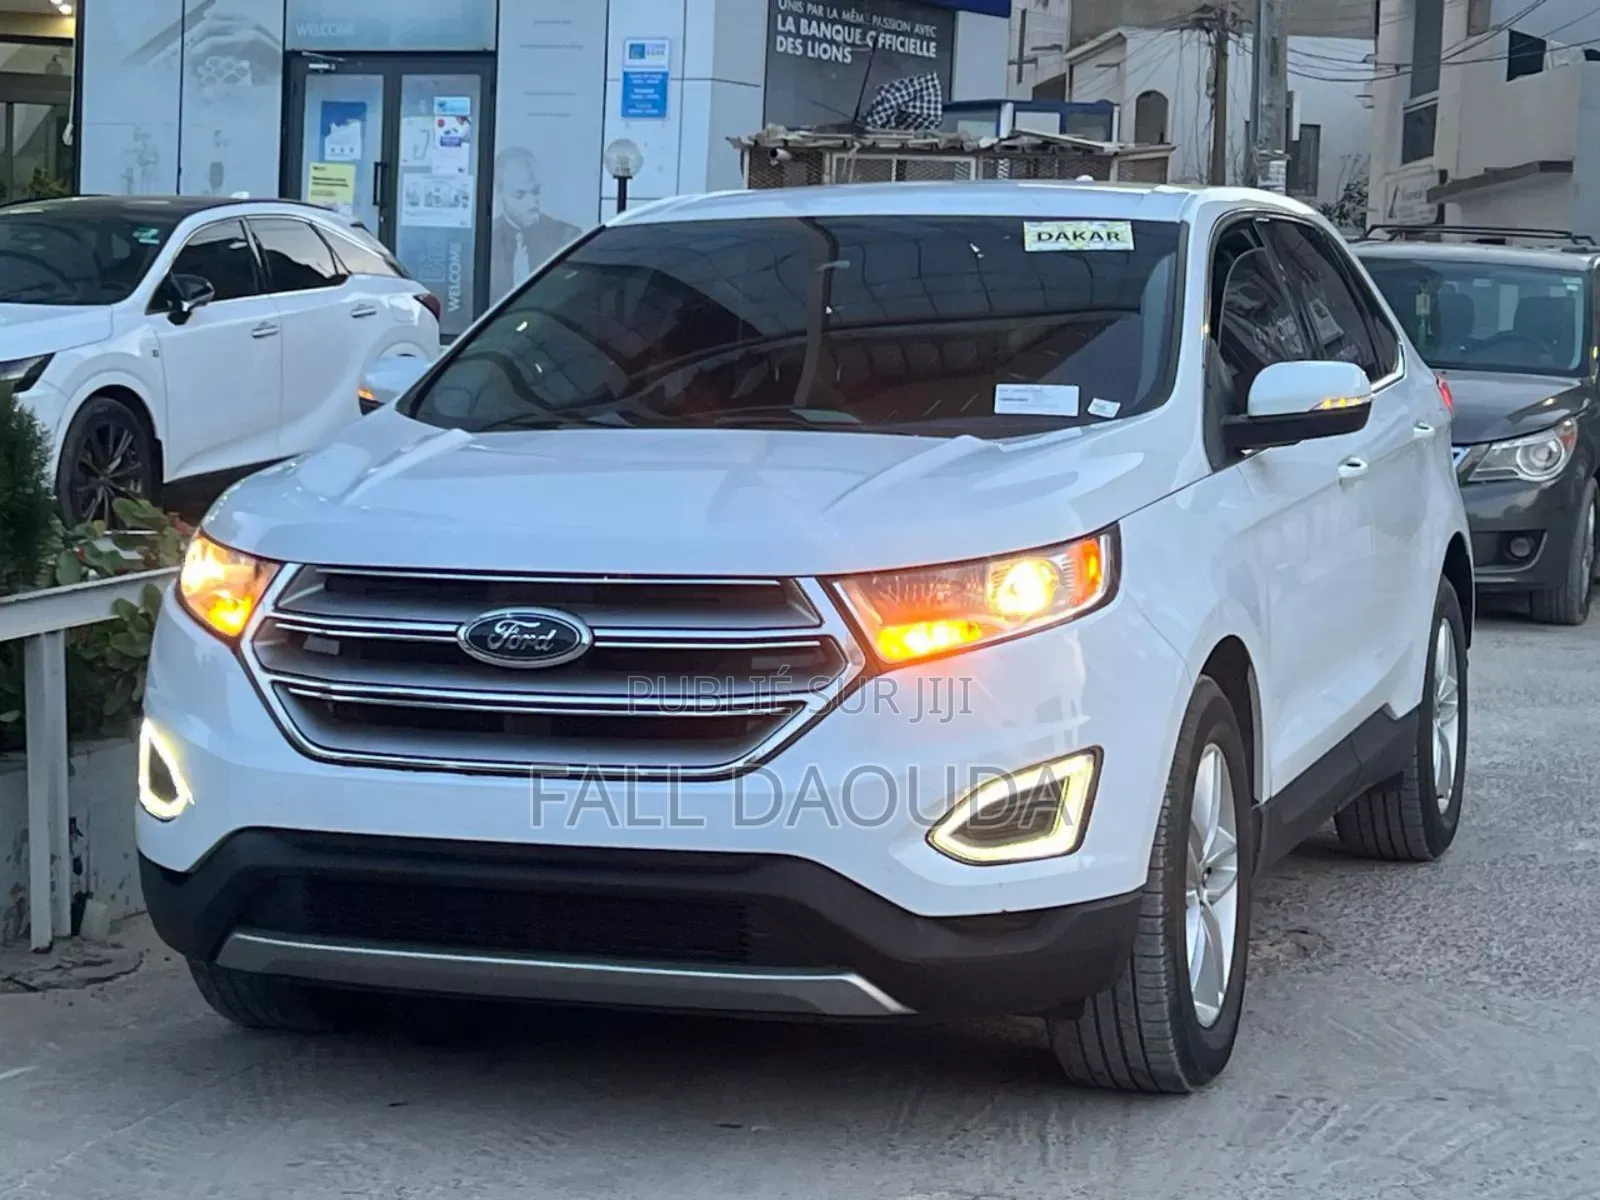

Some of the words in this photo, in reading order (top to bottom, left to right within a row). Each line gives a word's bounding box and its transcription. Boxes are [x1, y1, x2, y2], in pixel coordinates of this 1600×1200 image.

[777, 14, 796, 33] LA
[800, 17, 863, 45] BANQUE
[807, 2, 824, 17] PAR
[827, 7, 839, 20] LA
[842, 7, 868, 24] MÊM
[914, 23, 937, 38] AVEC
[776, 35, 803, 55] DES
[807, 40, 852, 64] LIONS
[1037, 230, 1121, 242] DAKAR
[448, 241, 461, 312] WELCOME
[487, 619, 557, 651] Ford
